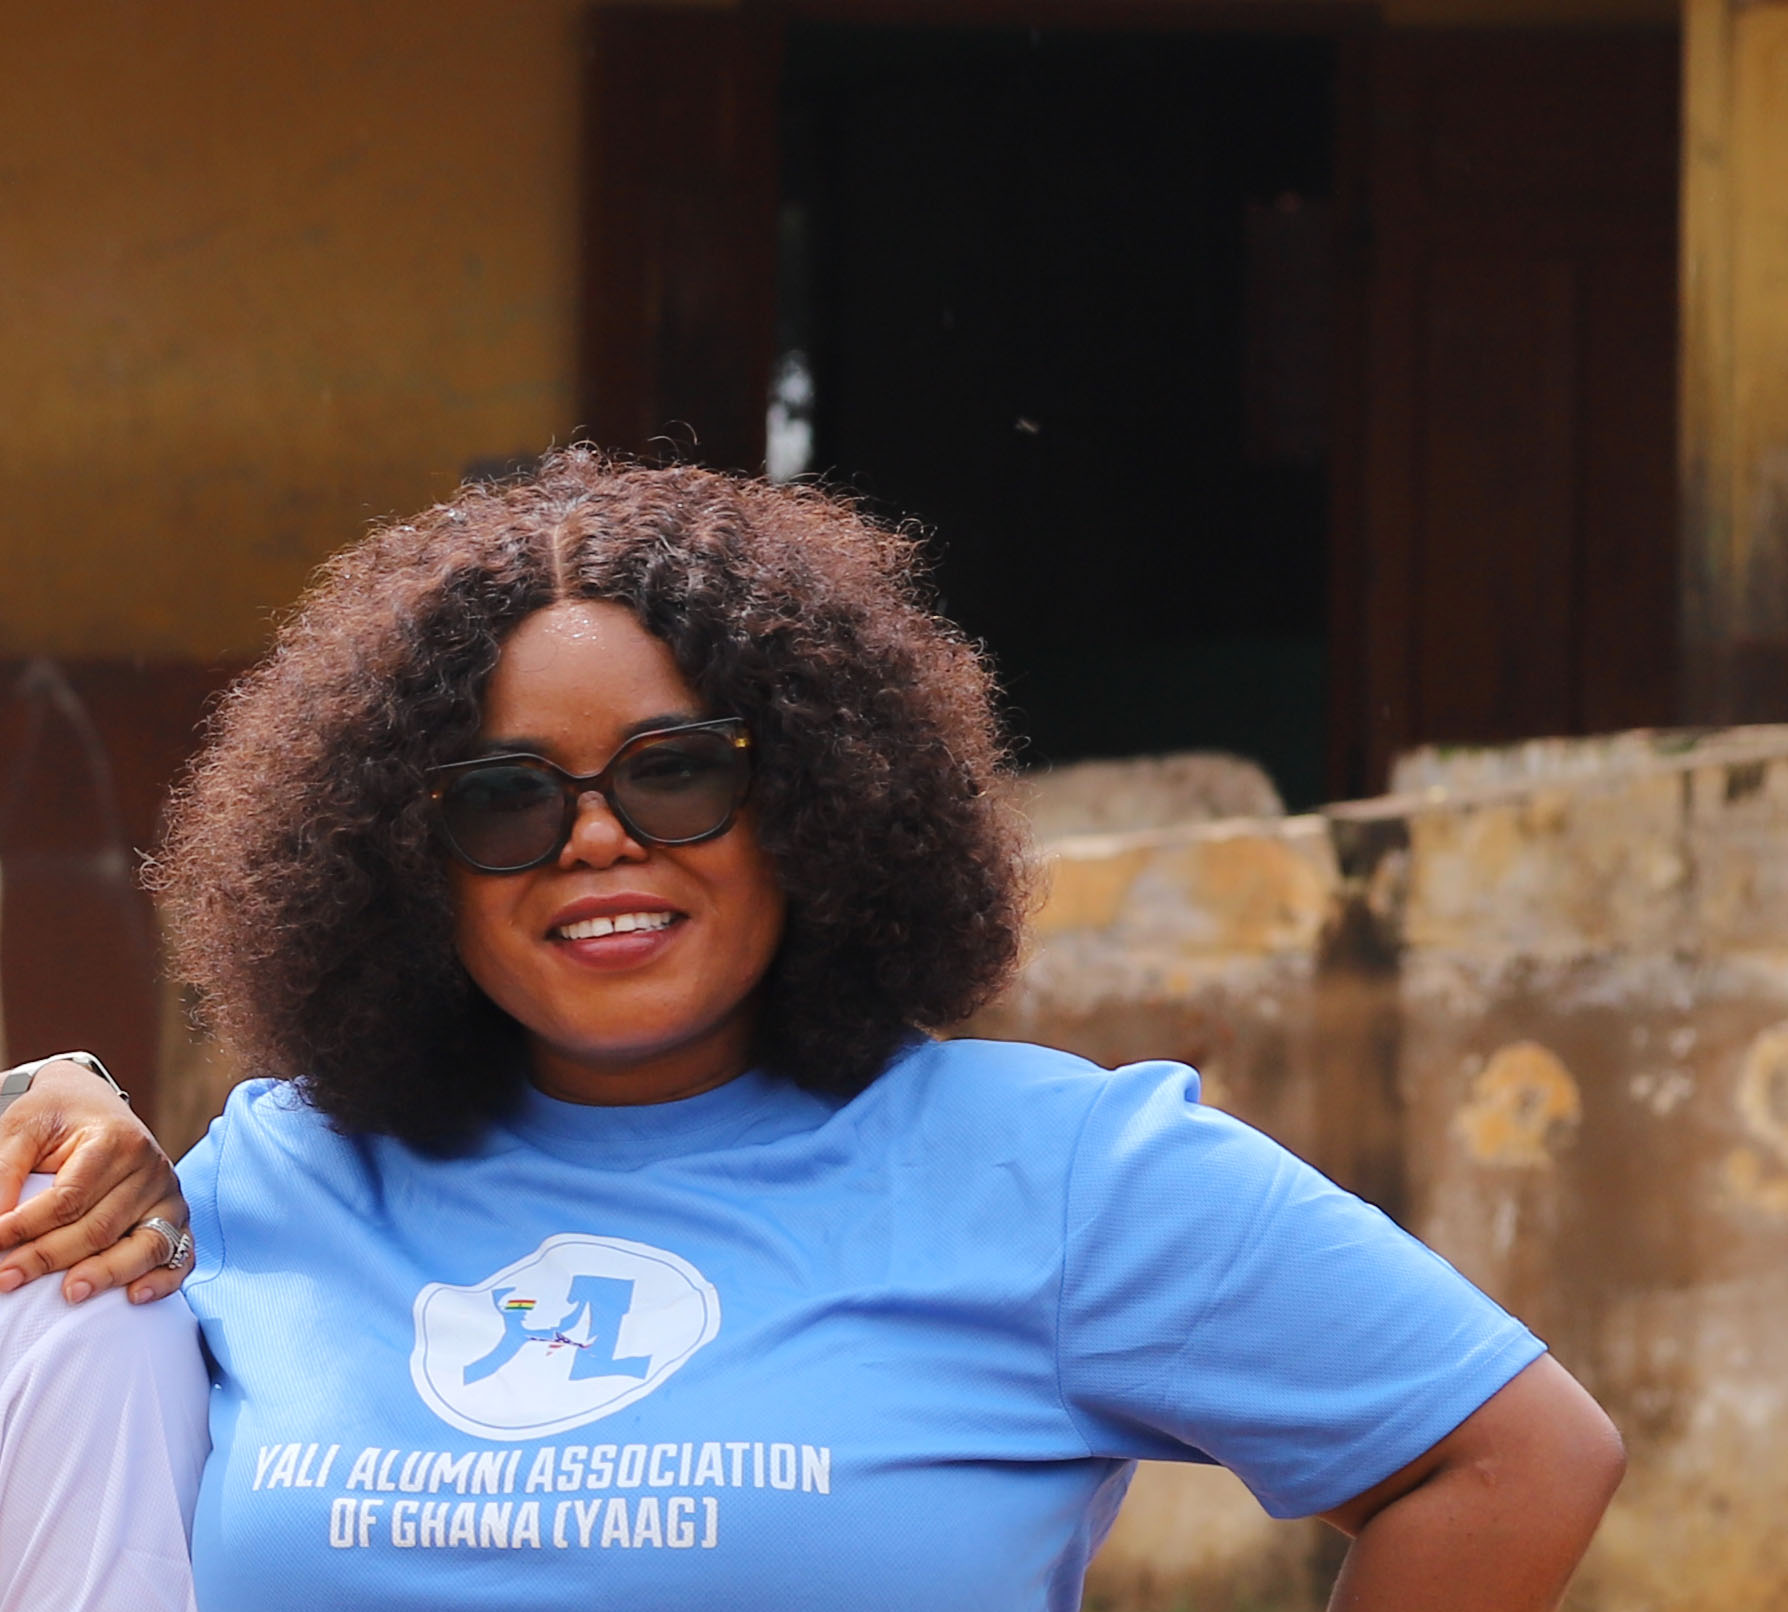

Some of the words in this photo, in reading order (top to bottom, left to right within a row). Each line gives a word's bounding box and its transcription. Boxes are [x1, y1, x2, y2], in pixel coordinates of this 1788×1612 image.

[252, 1442, 340, 1491] YALI
[345, 1446, 523, 1494] ALUMNI
[525, 1441, 831, 1495] ASSOCIATION
[329, 1497, 378, 1549] OF
[390, 1499, 541, 1549] GHANA
